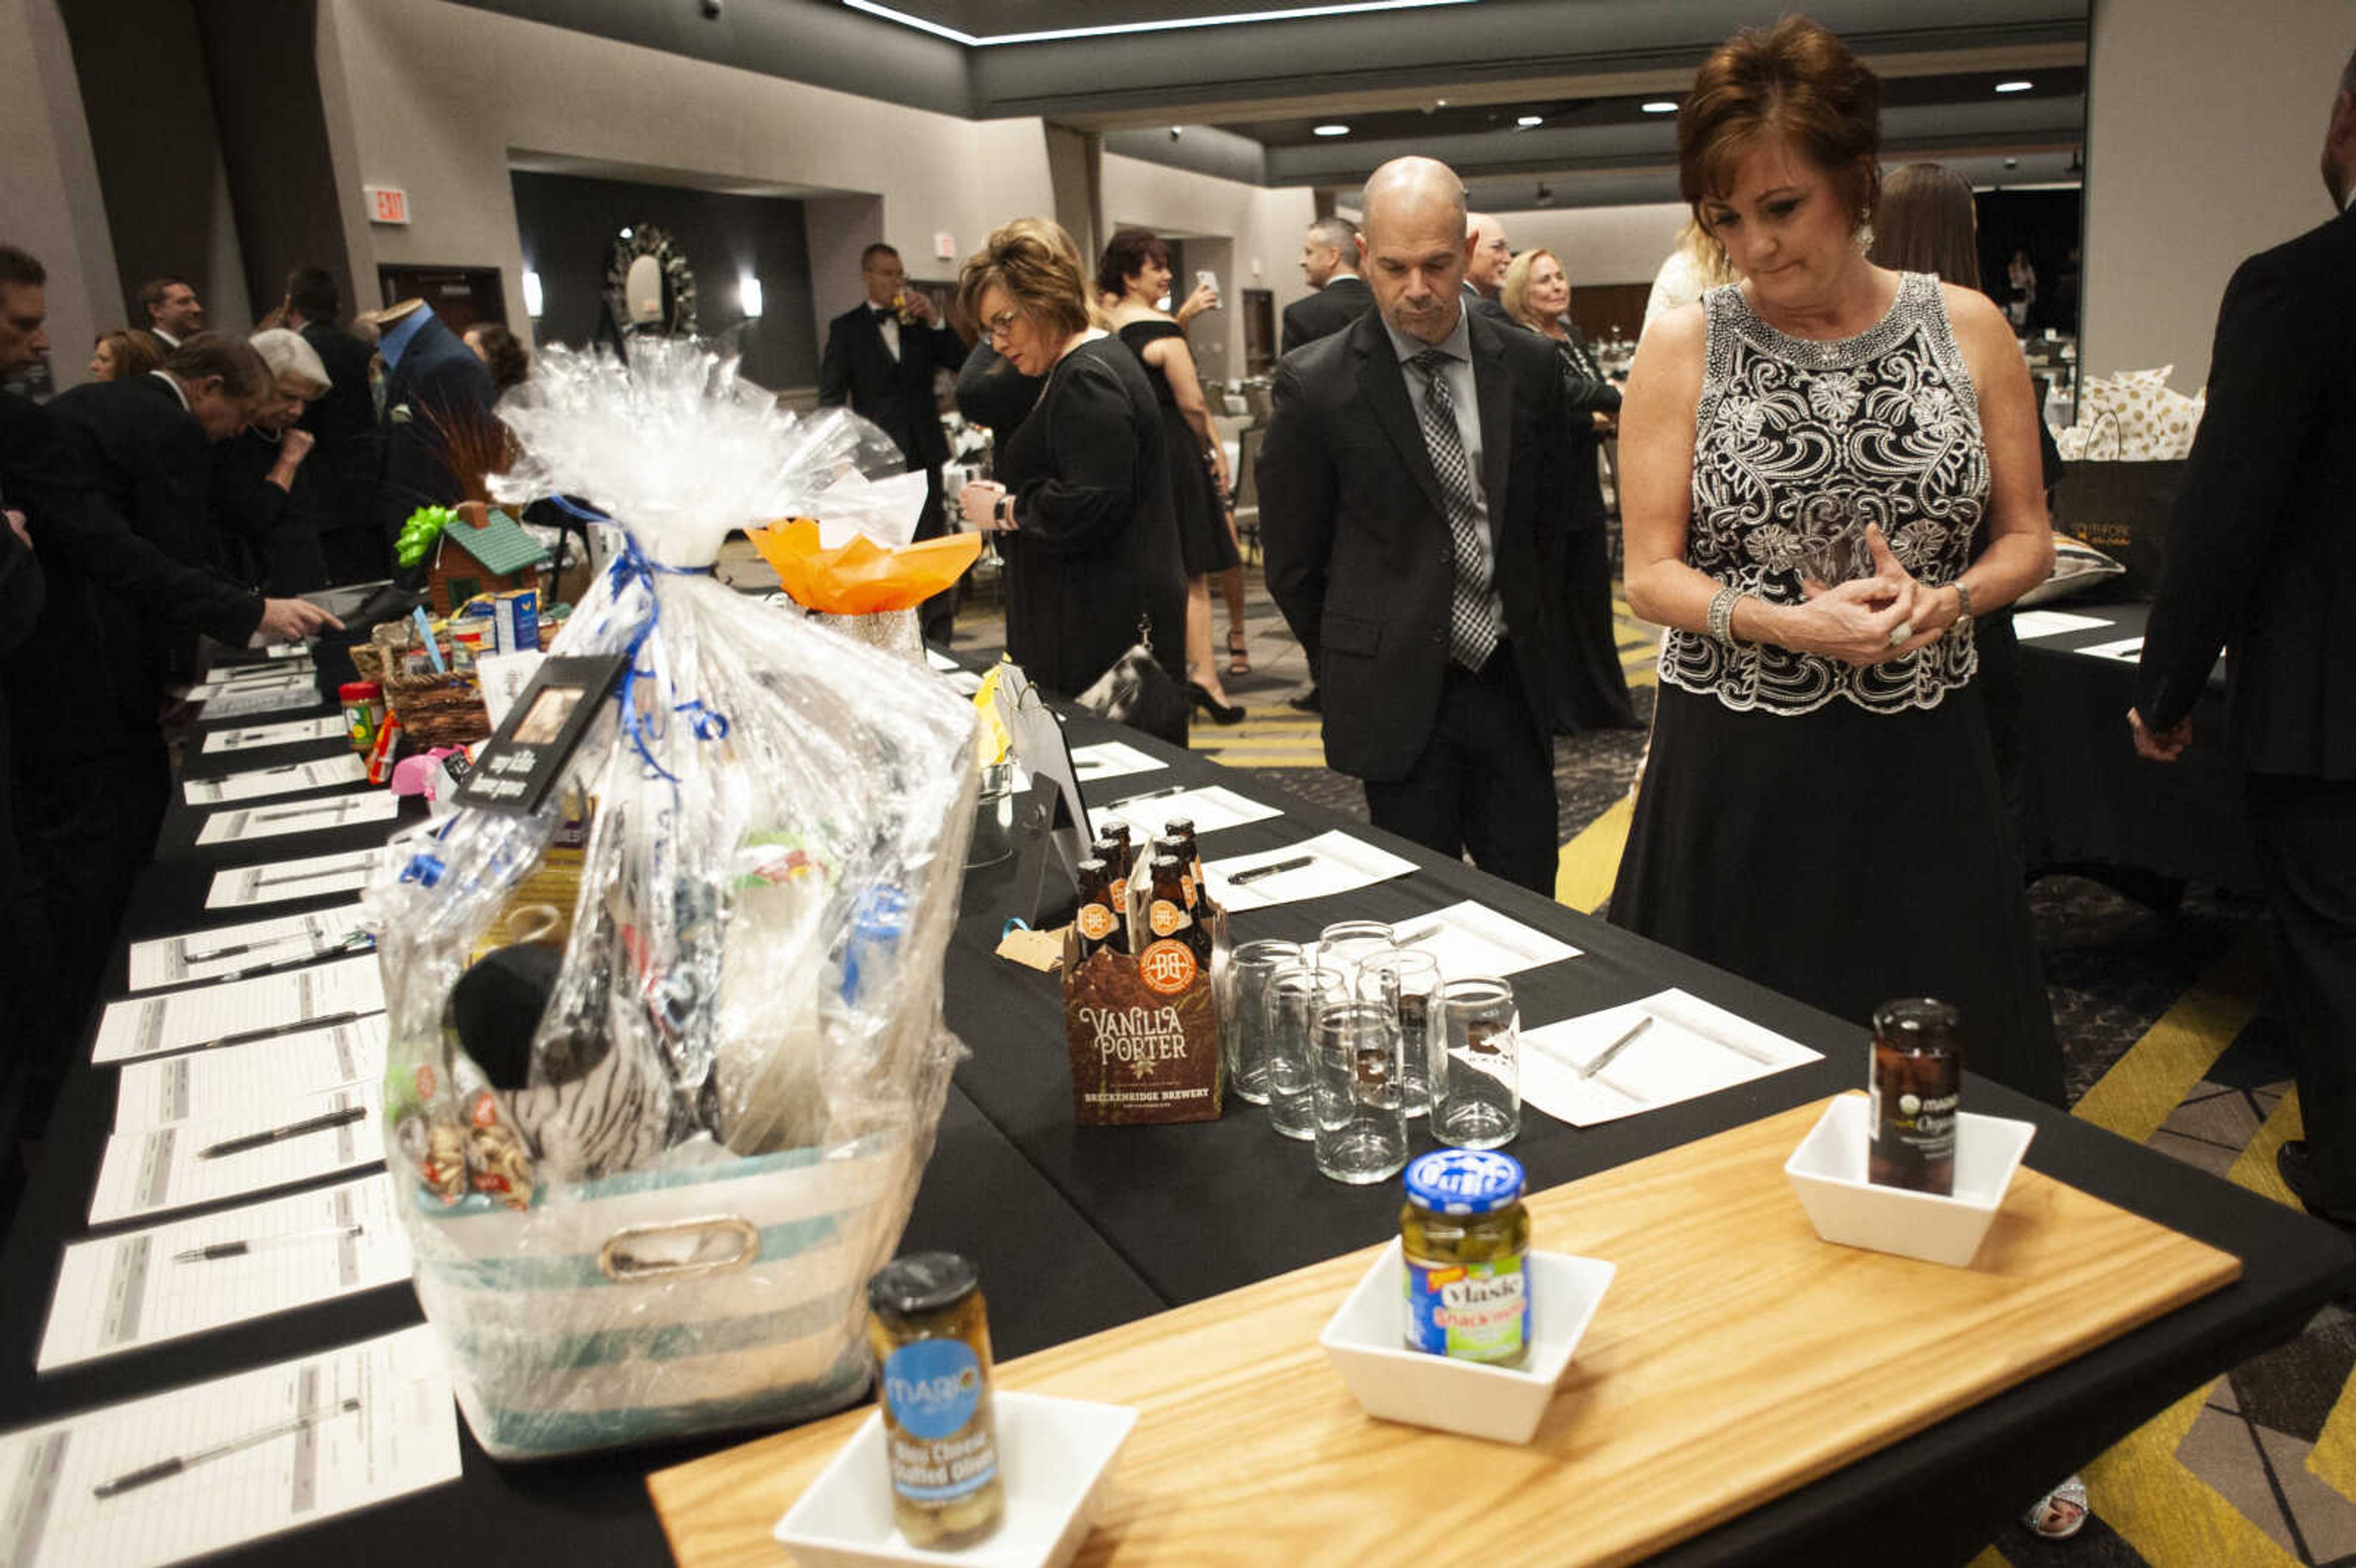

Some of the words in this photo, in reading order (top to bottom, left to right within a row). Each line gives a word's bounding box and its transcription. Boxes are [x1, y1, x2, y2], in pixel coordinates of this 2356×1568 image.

[376, 191, 403, 220] EXIT
[1079, 1007, 1184, 1037] VANILLA
[1094, 1034, 1187, 1065] PORTER
[1084, 1091, 1159, 1102] BRECKENRIDGE
[1161, 1088, 1209, 1101] BREWERY
